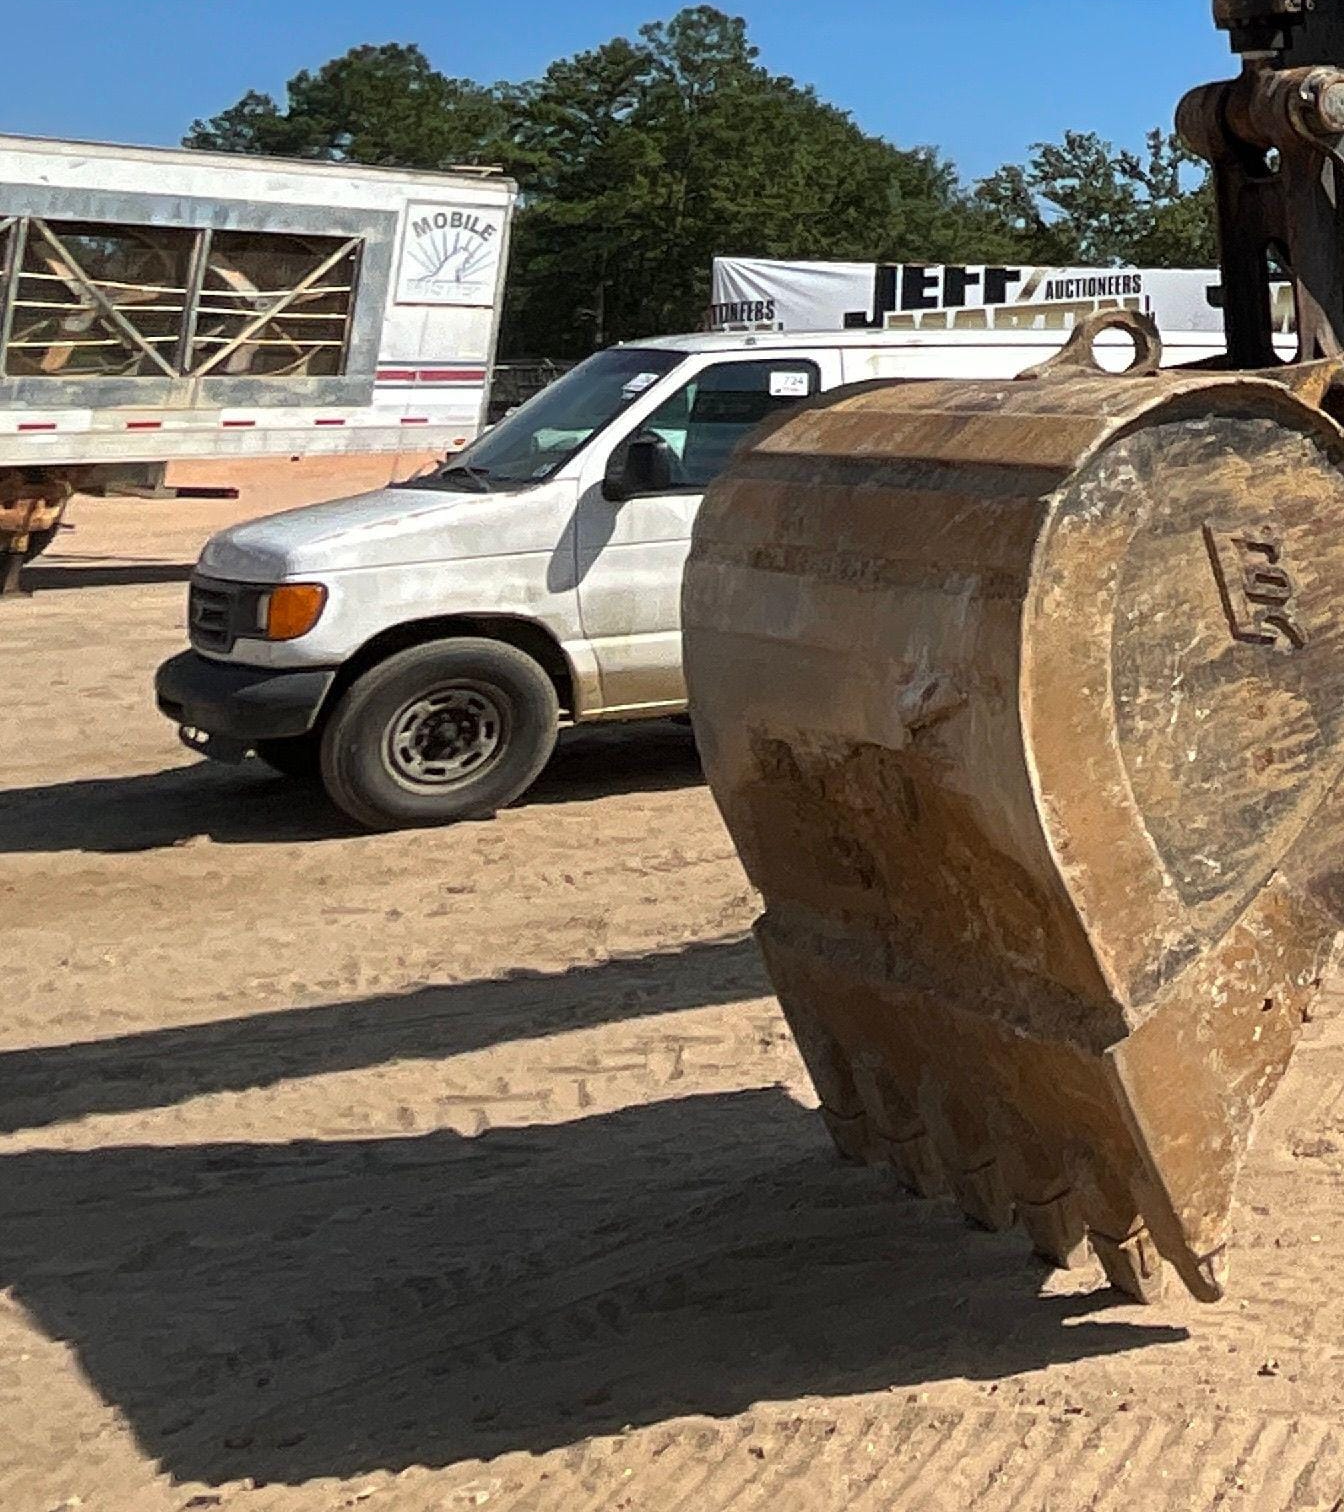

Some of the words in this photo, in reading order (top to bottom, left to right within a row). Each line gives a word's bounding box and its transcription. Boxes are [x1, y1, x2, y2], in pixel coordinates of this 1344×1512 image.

[412, 211, 497, 241] MOBILE
[843, 265, 1020, 330] JEFF
[1045, 274, 1142, 299] AUCTIONEERS
